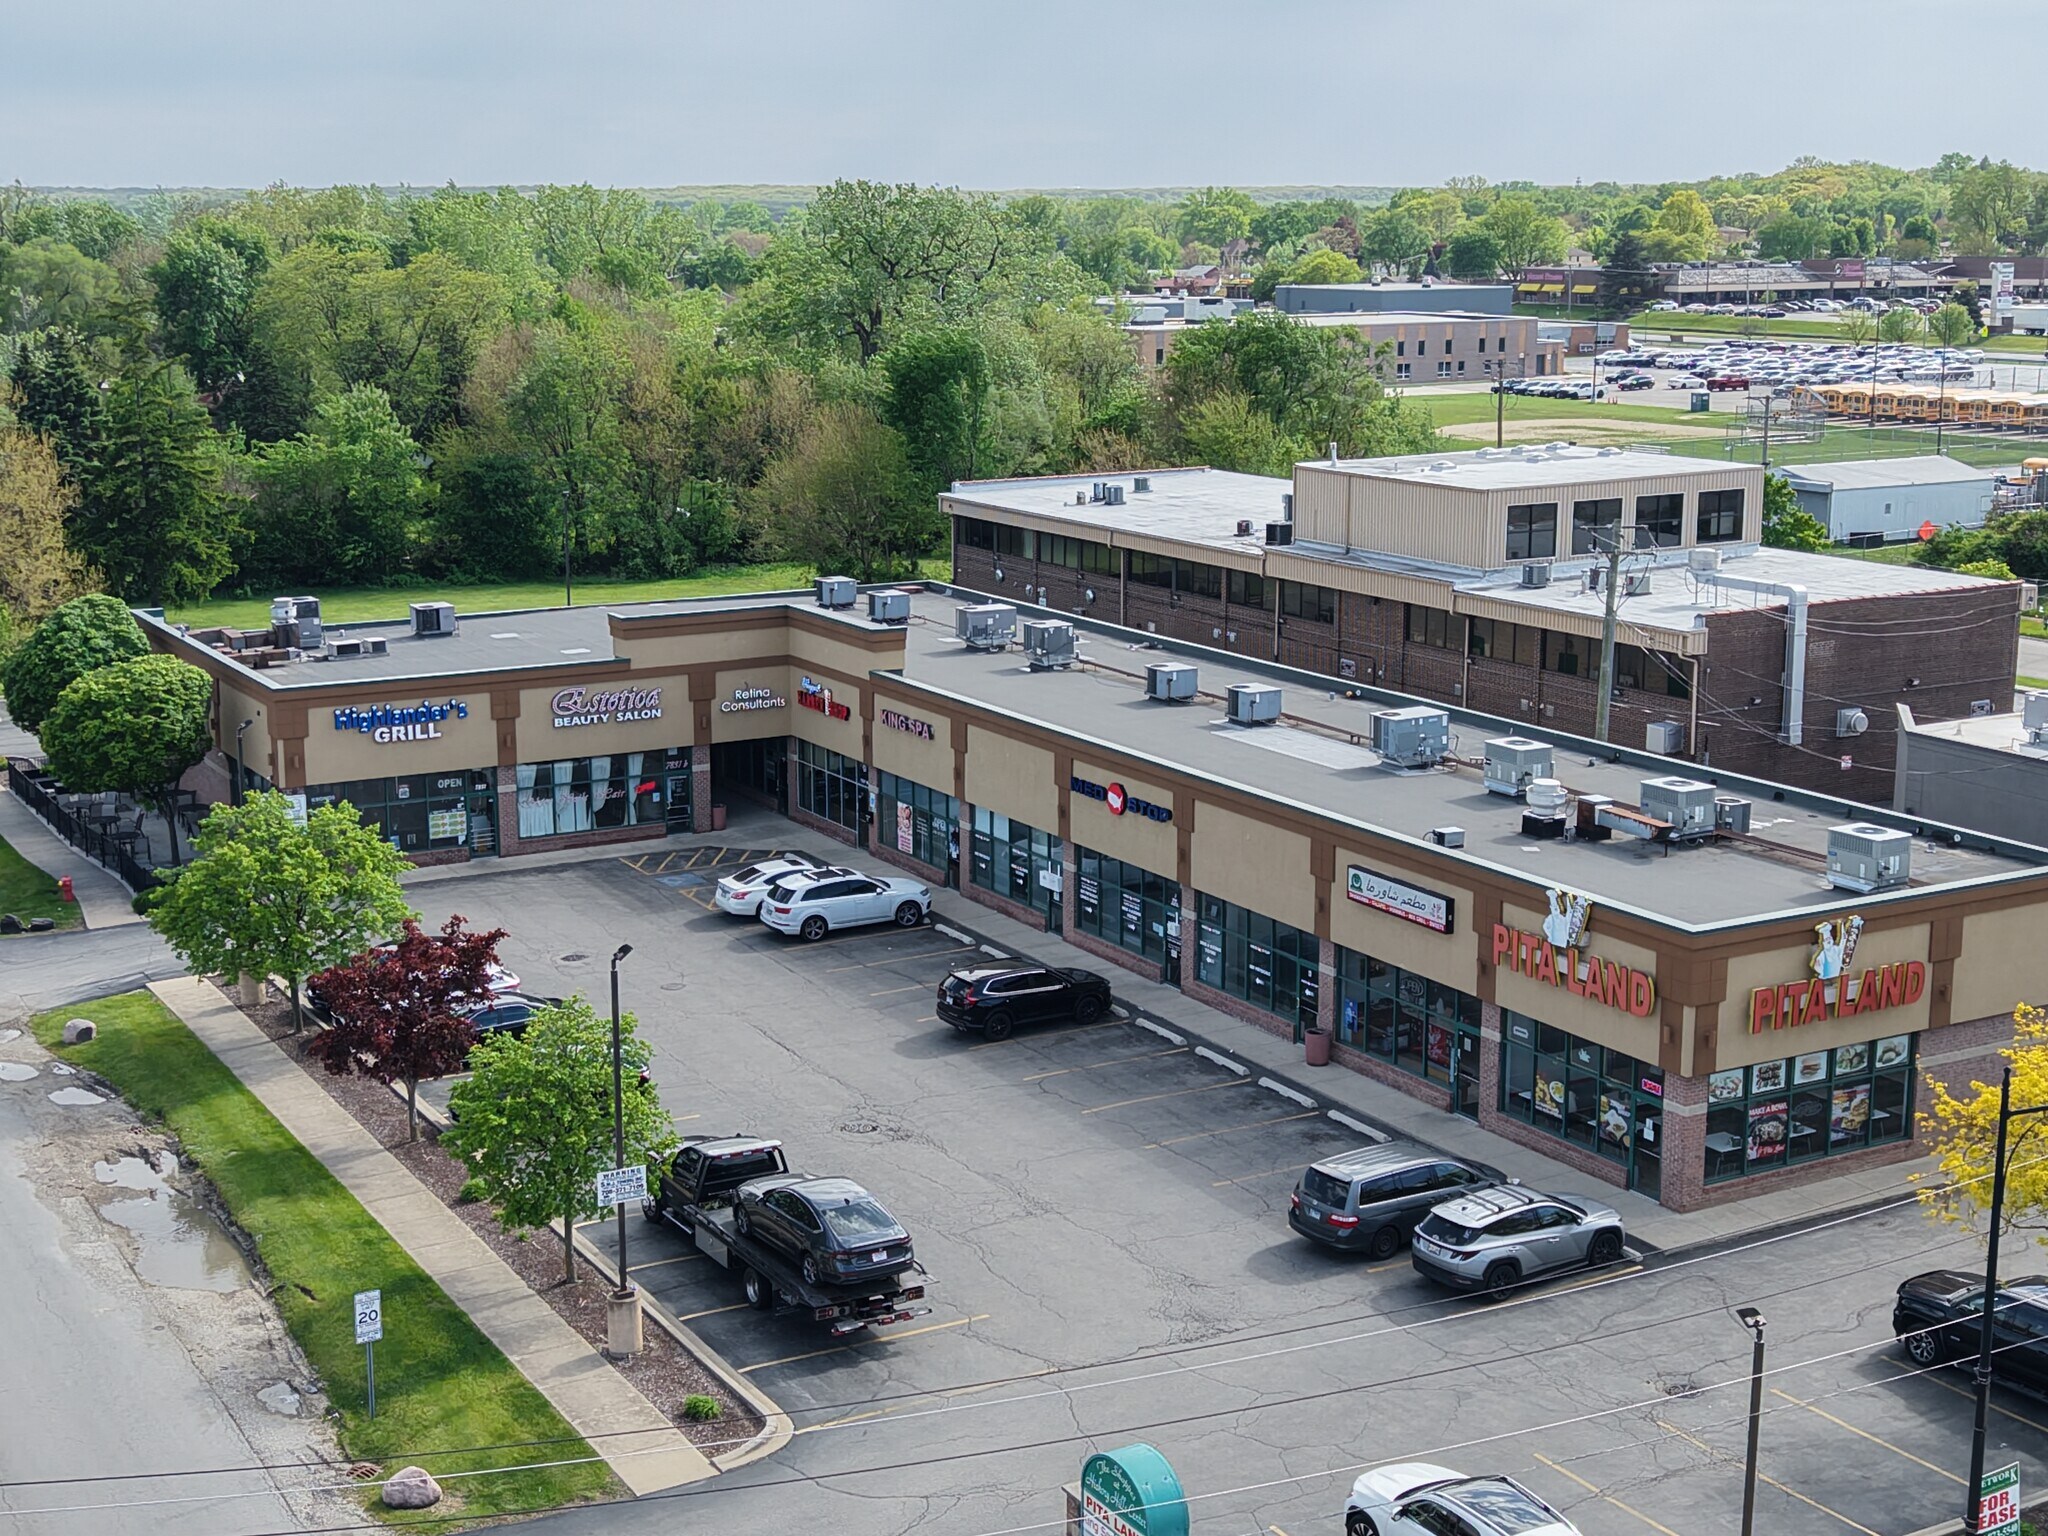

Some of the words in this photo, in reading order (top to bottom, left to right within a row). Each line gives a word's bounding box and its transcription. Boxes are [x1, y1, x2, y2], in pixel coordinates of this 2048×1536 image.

[721, 696, 786, 713] Consultants
[735, 688, 771, 700] Retina
[334, 699, 468, 733] Highlander's
[554, 713, 610, 728] BEAUTY
[616, 708, 662, 722] SALON
[879, 709, 906, 732] KING
[907, 717, 931, 740] SPA
[374, 722, 442, 743] GRILL
[437, 777, 463, 789] OPEN
[1071, 777, 1107, 801] MED
[1127, 797, 1173, 823] STOP
[1365, 879, 1400, 901] شاورما
[1400, 895, 1427, 911] مطعم
[1493, 922, 1560, 987] PITA
[1566, 947, 1656, 1018] LAND
[1751, 979, 1828, 1034] PITA
[1835, 961, 1926, 1019] LAND
[1749, 1107, 1766, 1116] MAKE
[1766, 1105, 1771, 1113] A
[603, 1167, 642, 1179] WARNING
[358, 1309, 378, 1324] 20
[1981, 1467, 2017, 1488] ETWORK
[1087, 1496, 1110, 1524] PITA
[1979, 1491, 2009, 1514] FOR
[1978, 1503, 2017, 1530] EASE
